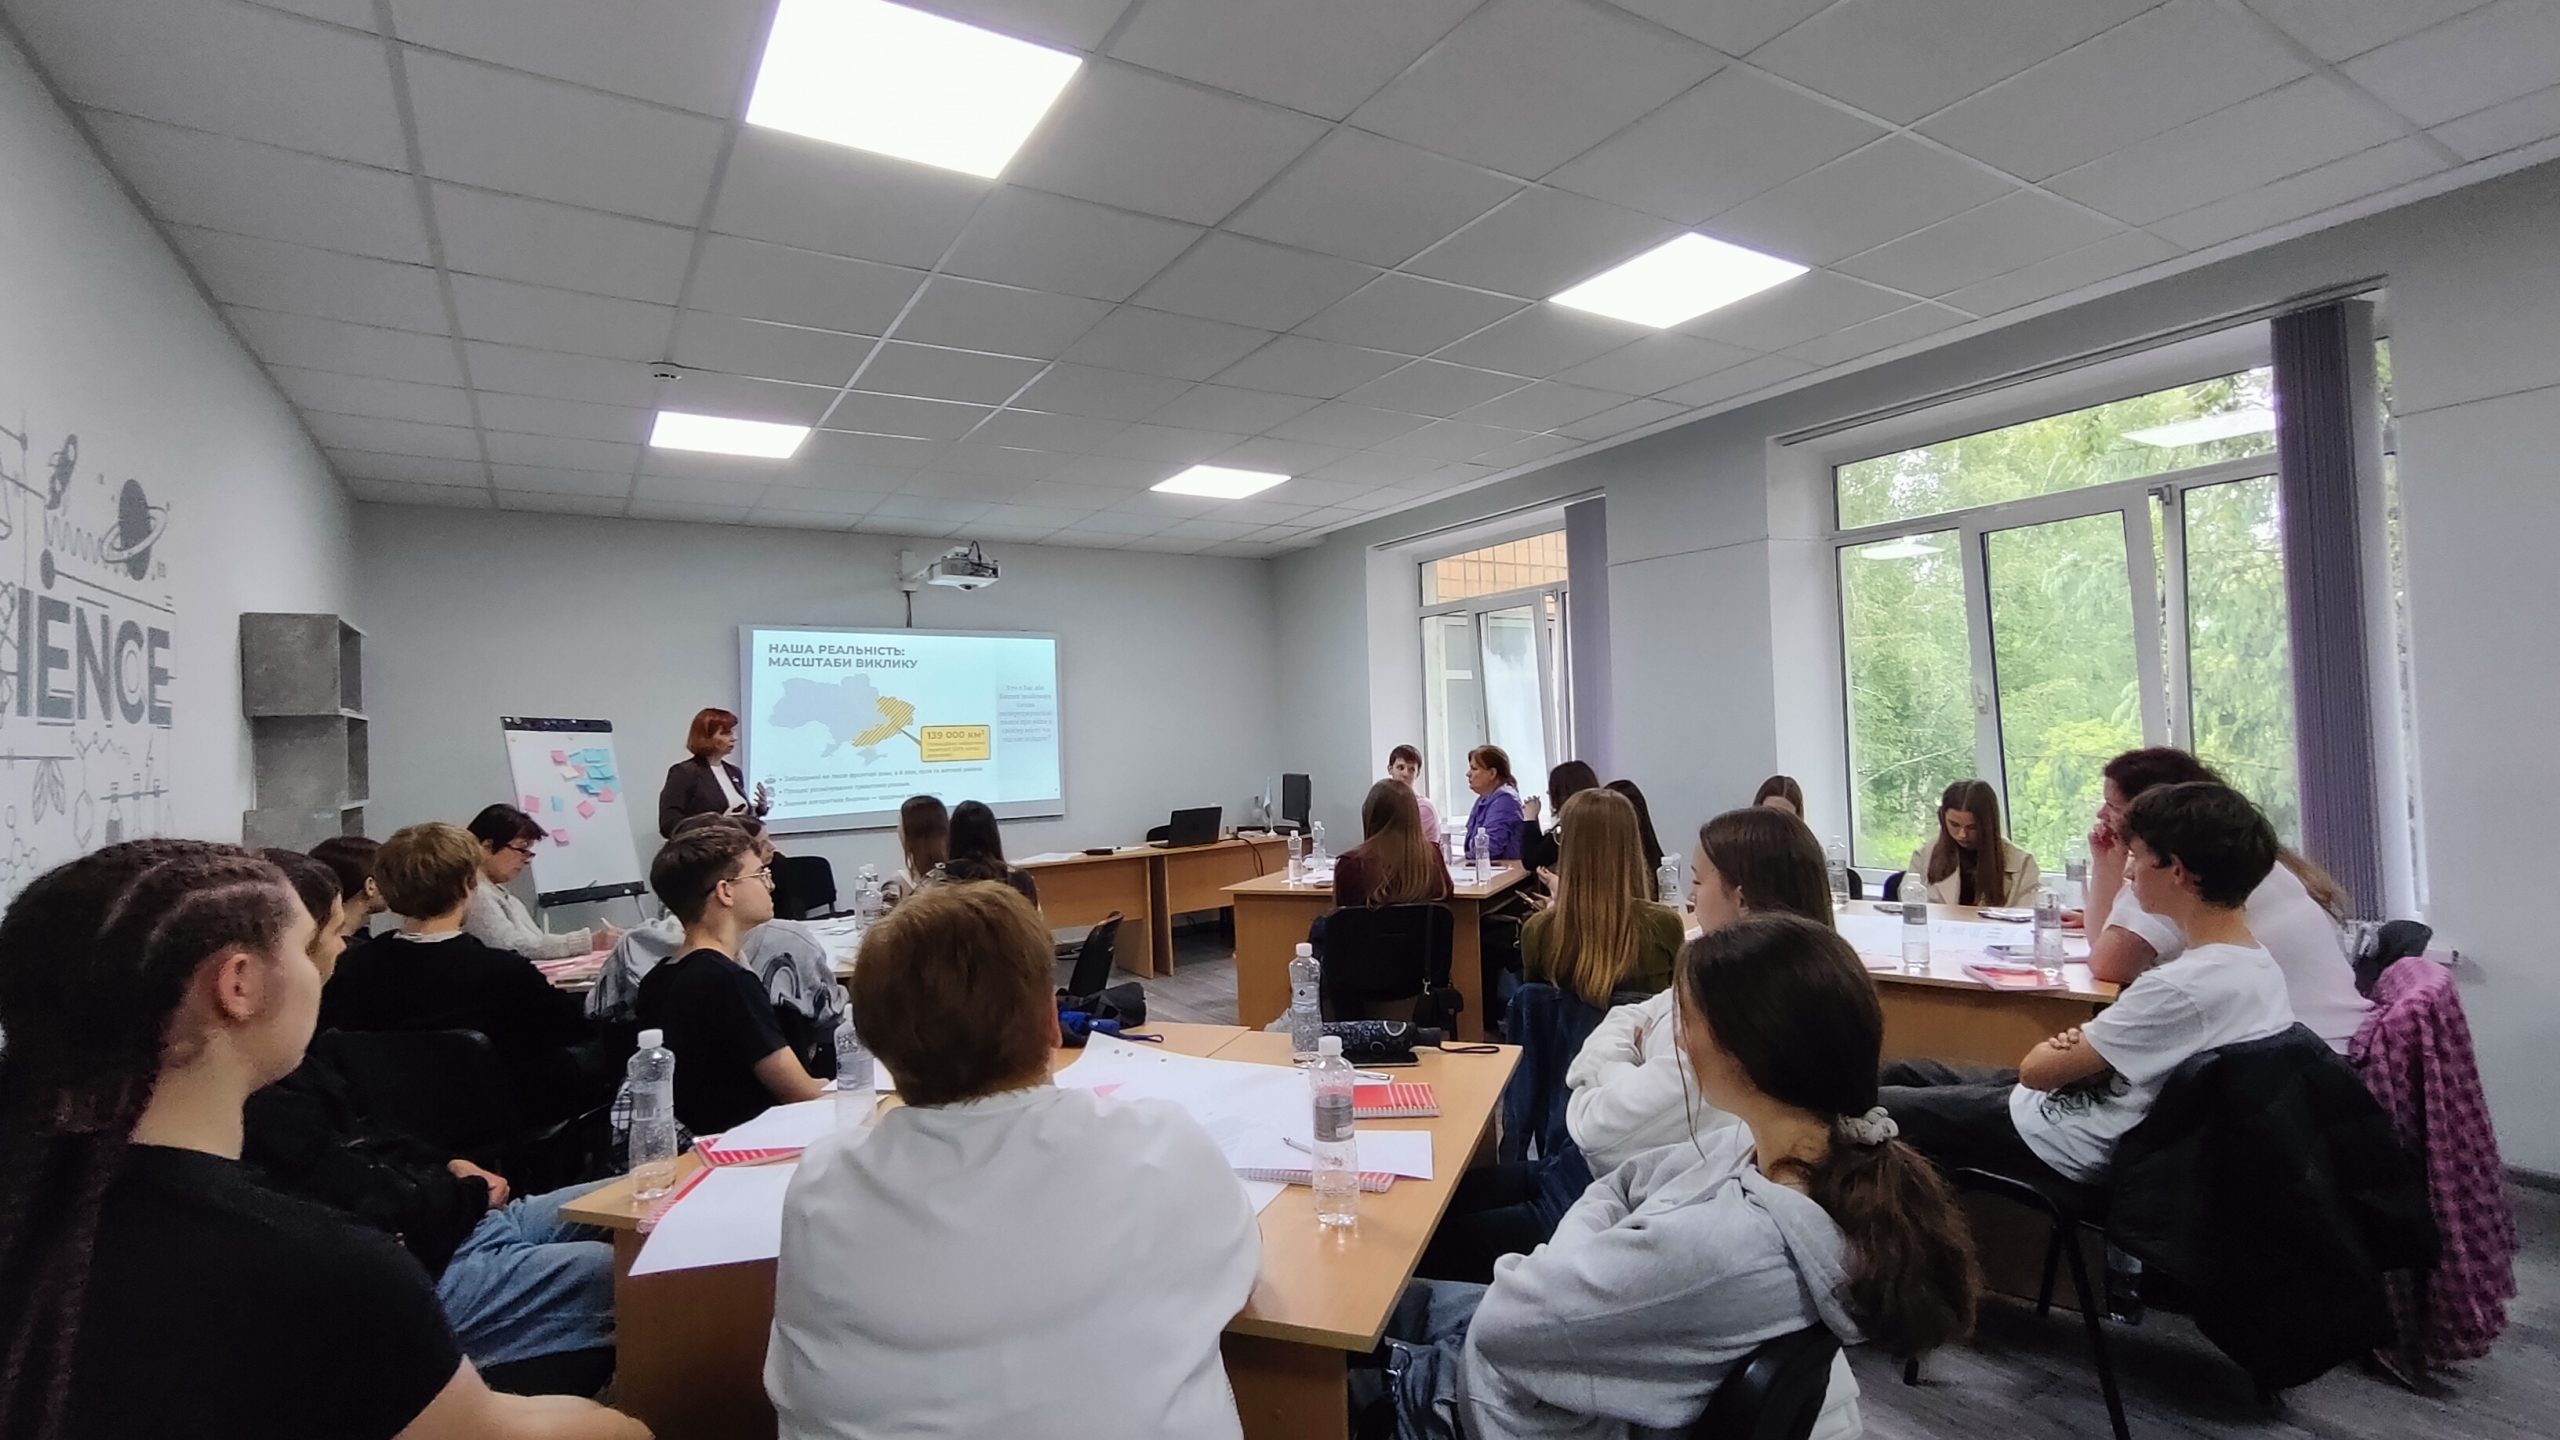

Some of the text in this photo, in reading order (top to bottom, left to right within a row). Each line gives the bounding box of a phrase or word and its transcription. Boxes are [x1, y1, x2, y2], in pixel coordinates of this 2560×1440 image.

[768, 643, 905, 656] НАША РЕАЛЬНІСТЬ:
[768, 657, 918, 669] МАСШТАБИ ВИКЛИКУ
[927, 731, 943, 740] 139
[945, 731, 965, 739] 000
